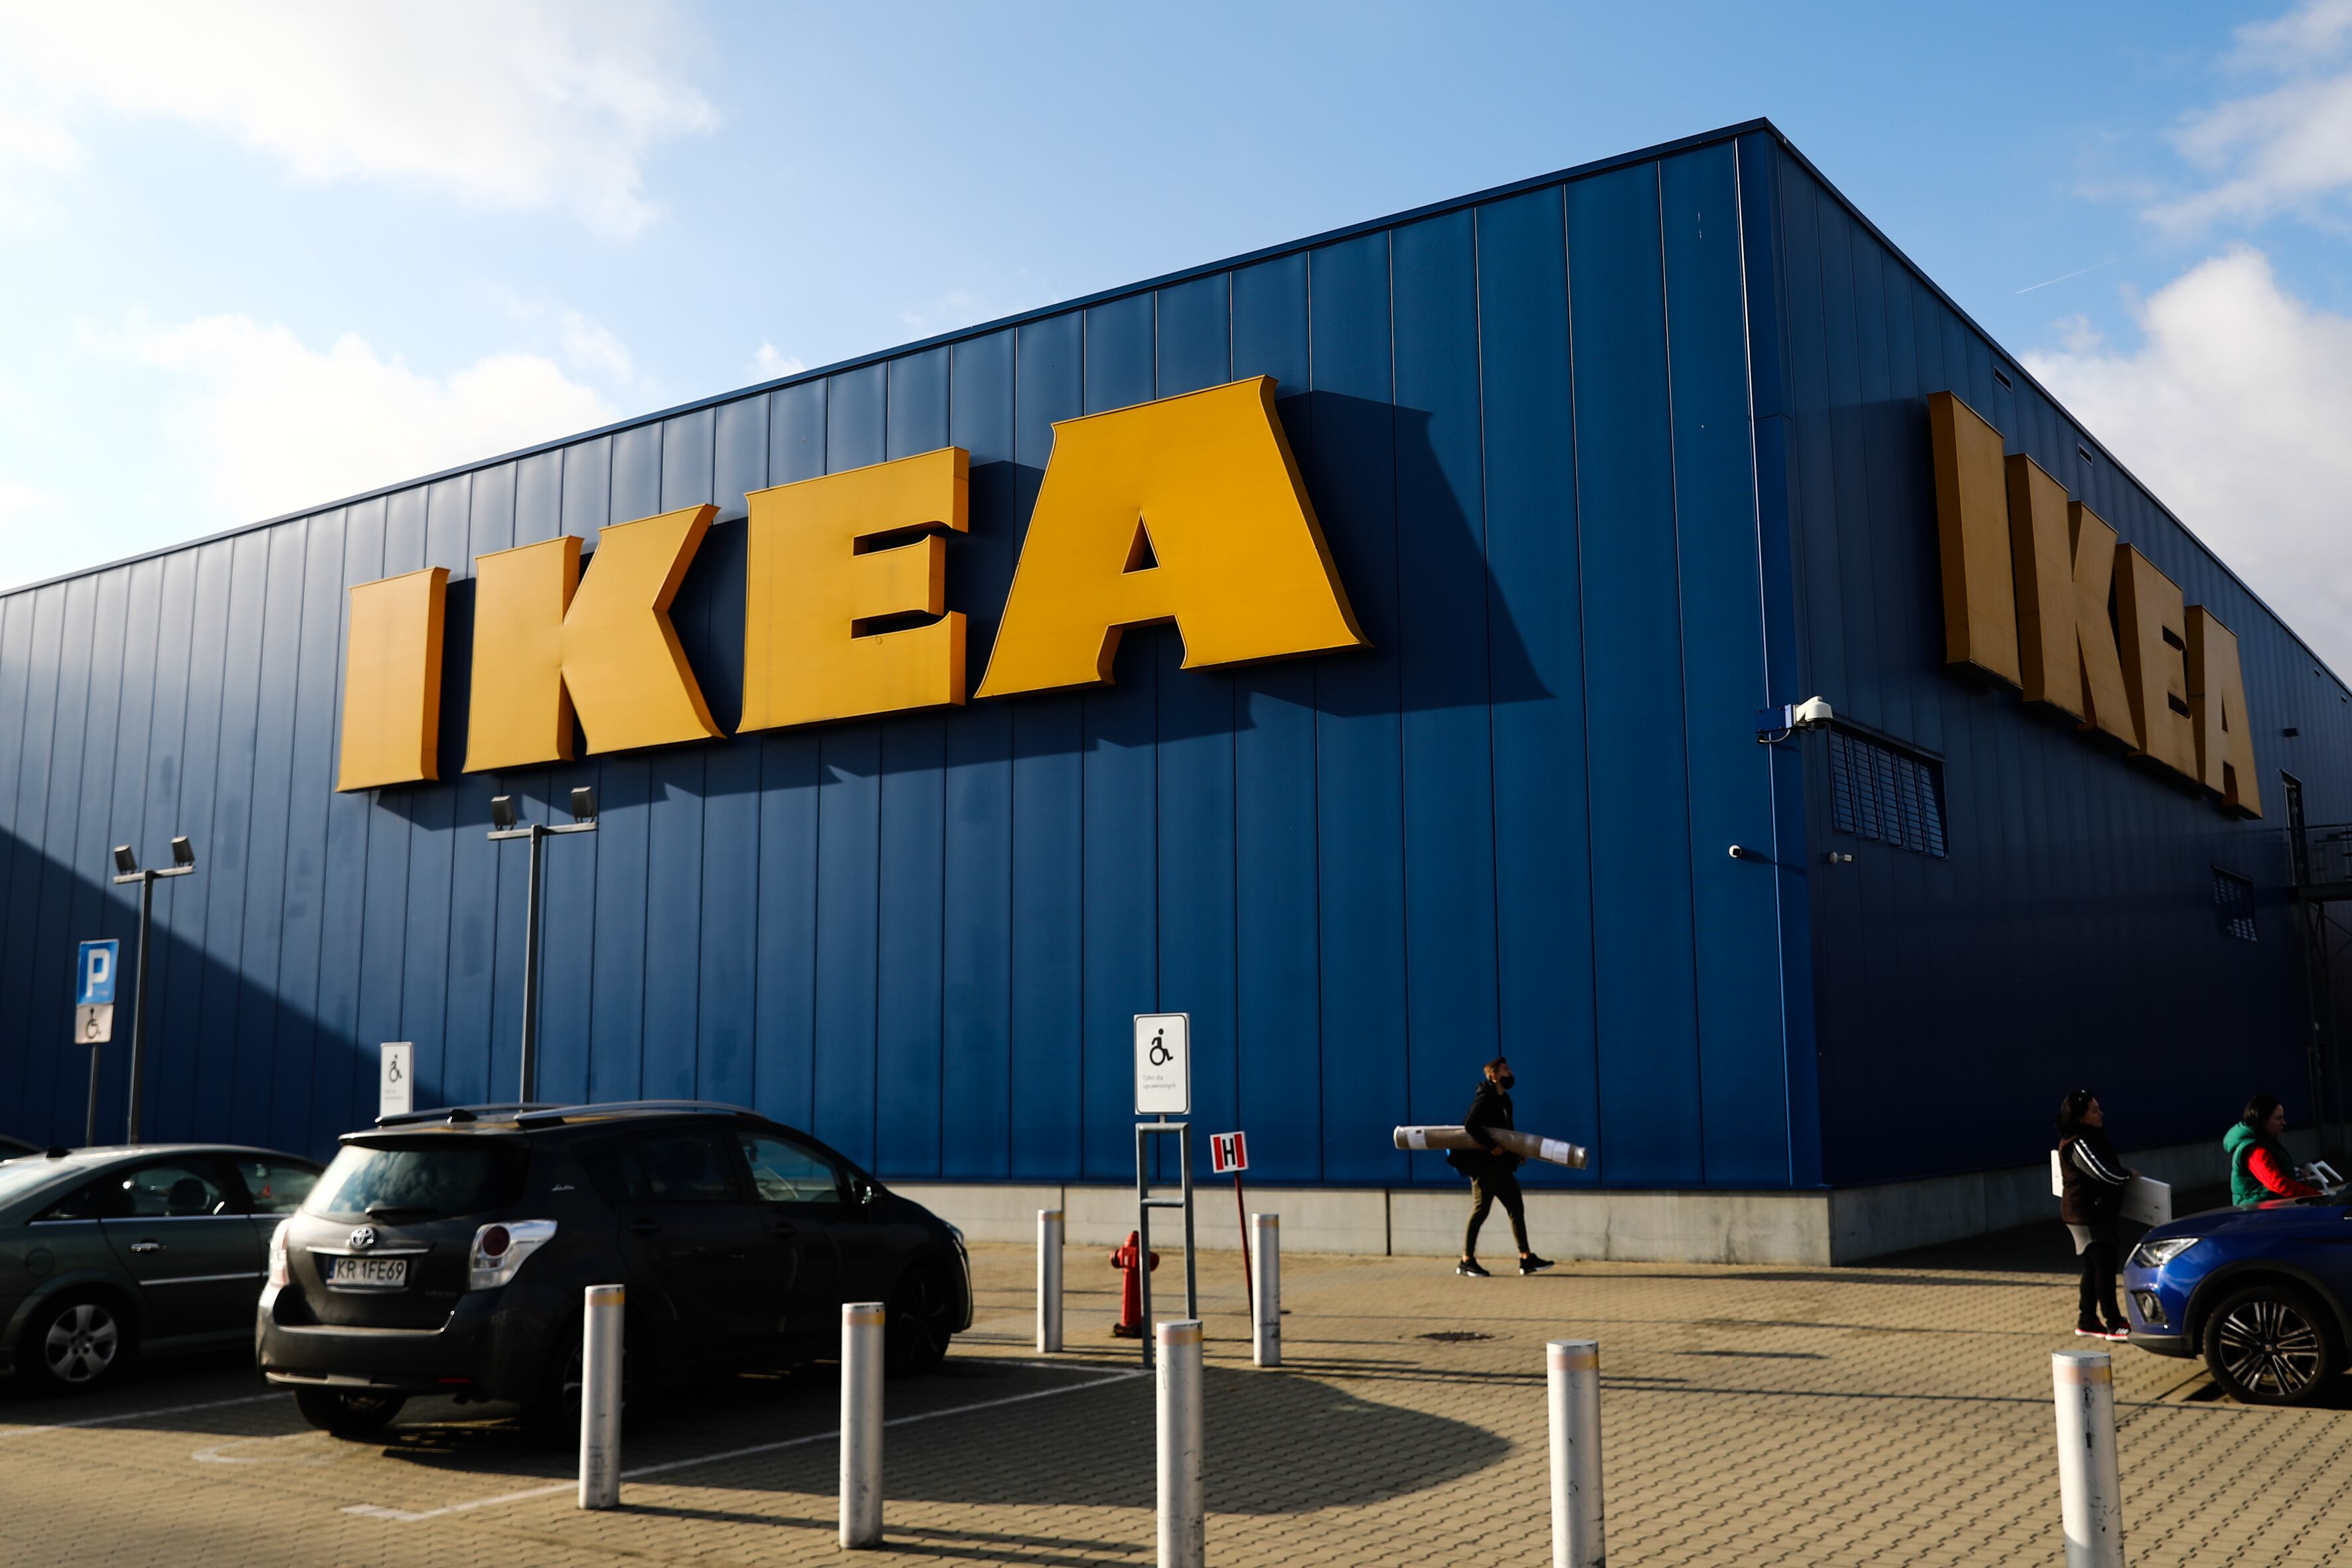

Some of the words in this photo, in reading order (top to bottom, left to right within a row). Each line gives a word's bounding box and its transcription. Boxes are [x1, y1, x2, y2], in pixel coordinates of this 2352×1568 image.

[336, 374, 1374, 793] IKEA
[1926, 390, 2263, 820] IKEA
[86, 948, 110, 998] P
[1222, 1138, 1235, 1166] H
[337, 1261, 356, 1279] KR
[363, 1261, 404, 1281] 1FE69
